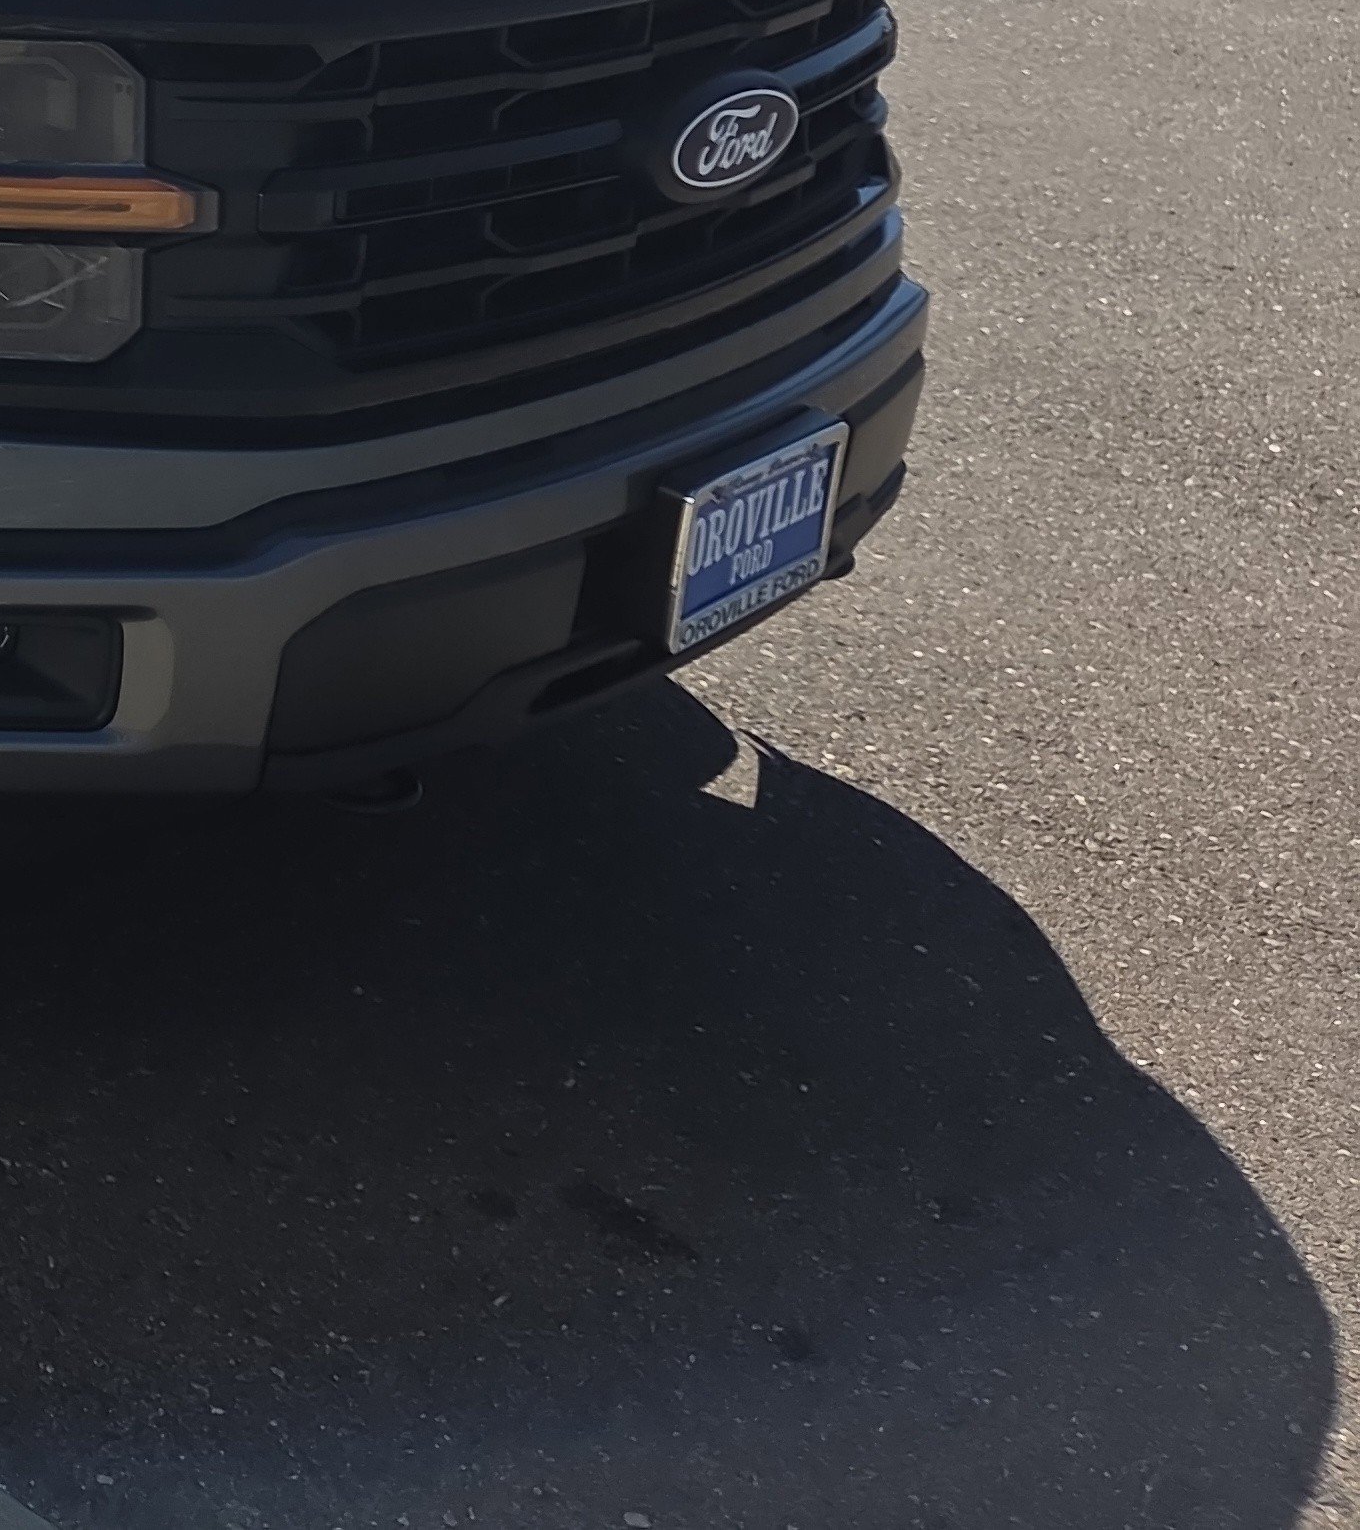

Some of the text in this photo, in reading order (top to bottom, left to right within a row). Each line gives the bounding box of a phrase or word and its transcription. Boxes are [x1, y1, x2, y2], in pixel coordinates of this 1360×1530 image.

[698, 104, 778, 176] Ford
[687, 458, 829, 577] OROVILLE
[681, 558, 821, 646] OROVILLE FORD
[730, 539, 773, 585] FORD
